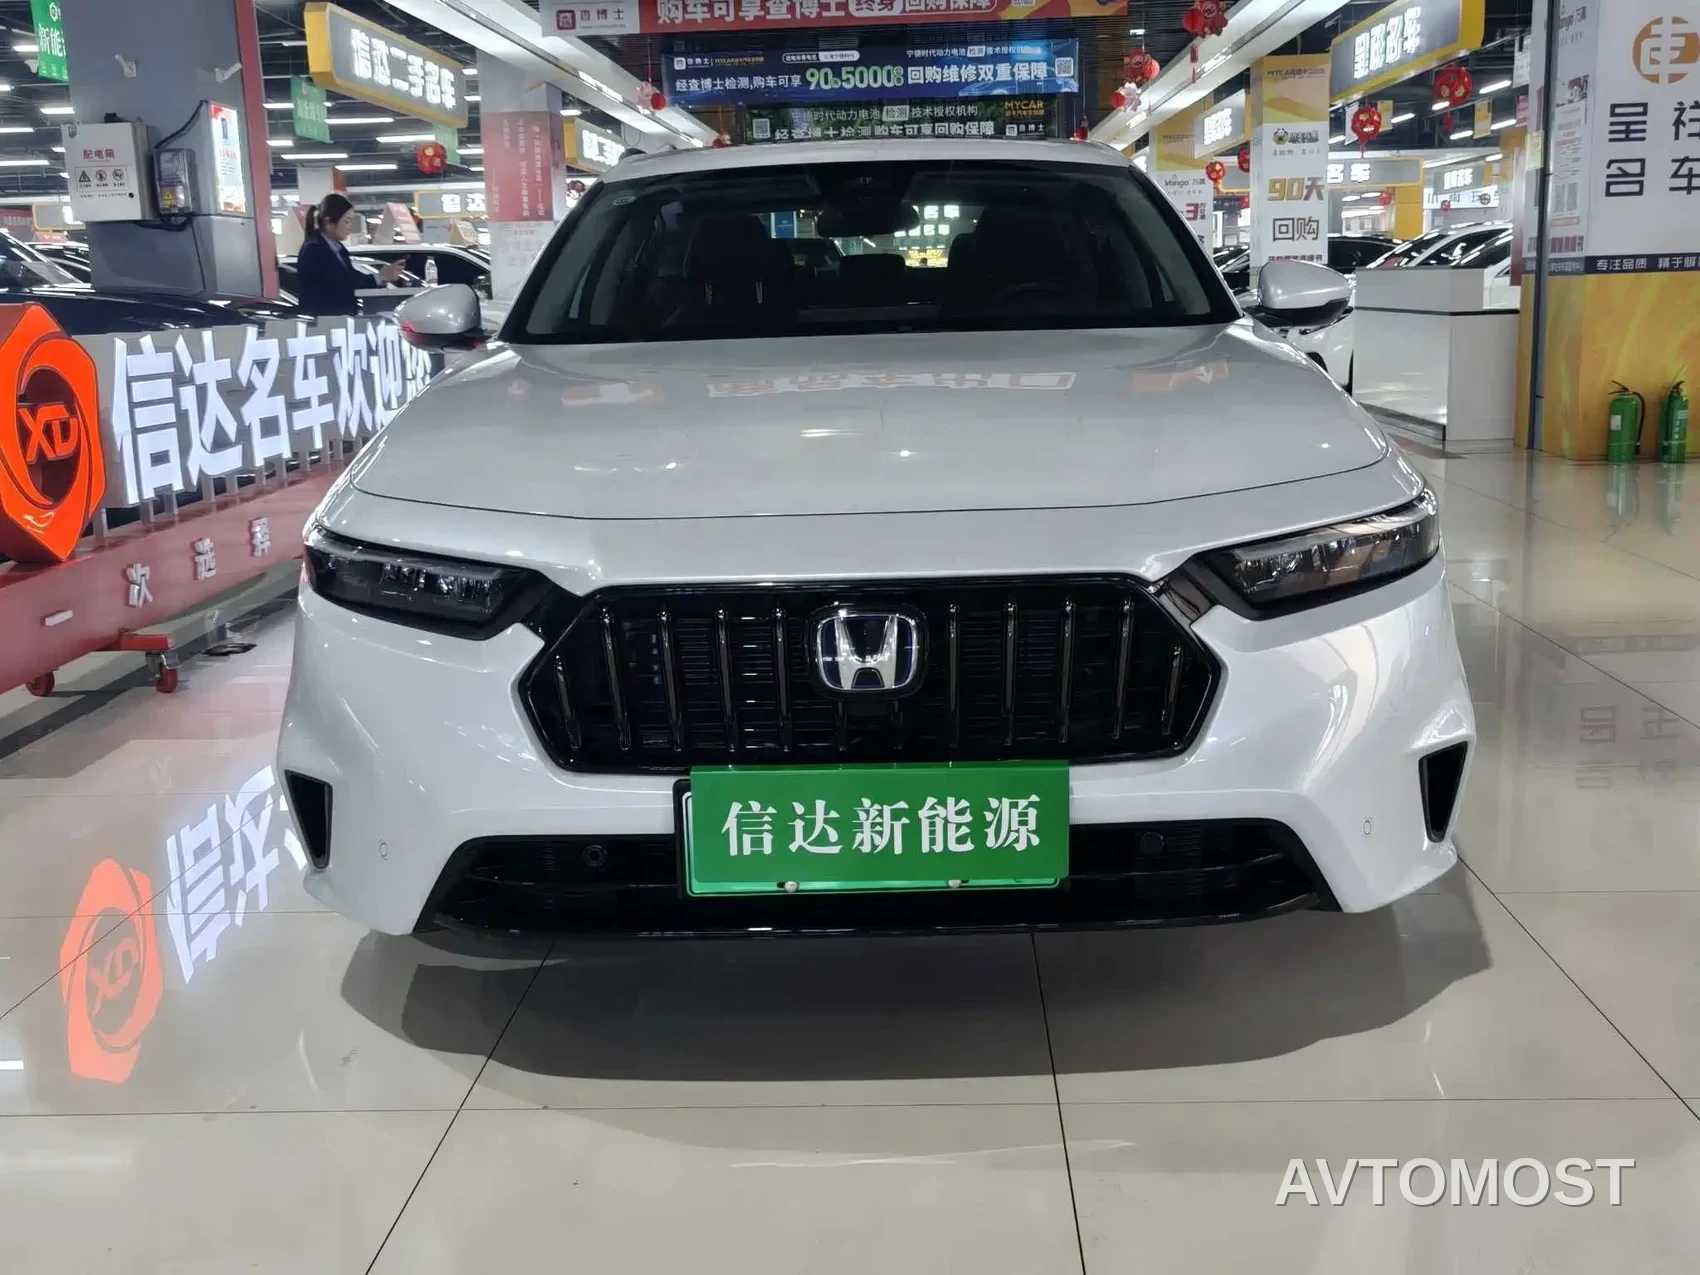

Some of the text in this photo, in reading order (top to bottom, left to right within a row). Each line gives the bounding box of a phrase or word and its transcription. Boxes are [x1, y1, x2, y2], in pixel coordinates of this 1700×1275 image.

[351, 28, 457, 110] 信达二手名车
[907, 62, 1048, 84] 回购维修双重保障
[1005, 100, 1044, 110] MYCAR
[1267, 177, 1325, 202] 90天
[1605, 156, 1700, 198] 名车
[1272, 216, 1320, 242] 回购
[1596, 258, 1648, 271] 专注品质
[1657, 255, 1700, 269] 精于服
[721, 794, 1041, 857] 信达新能源
